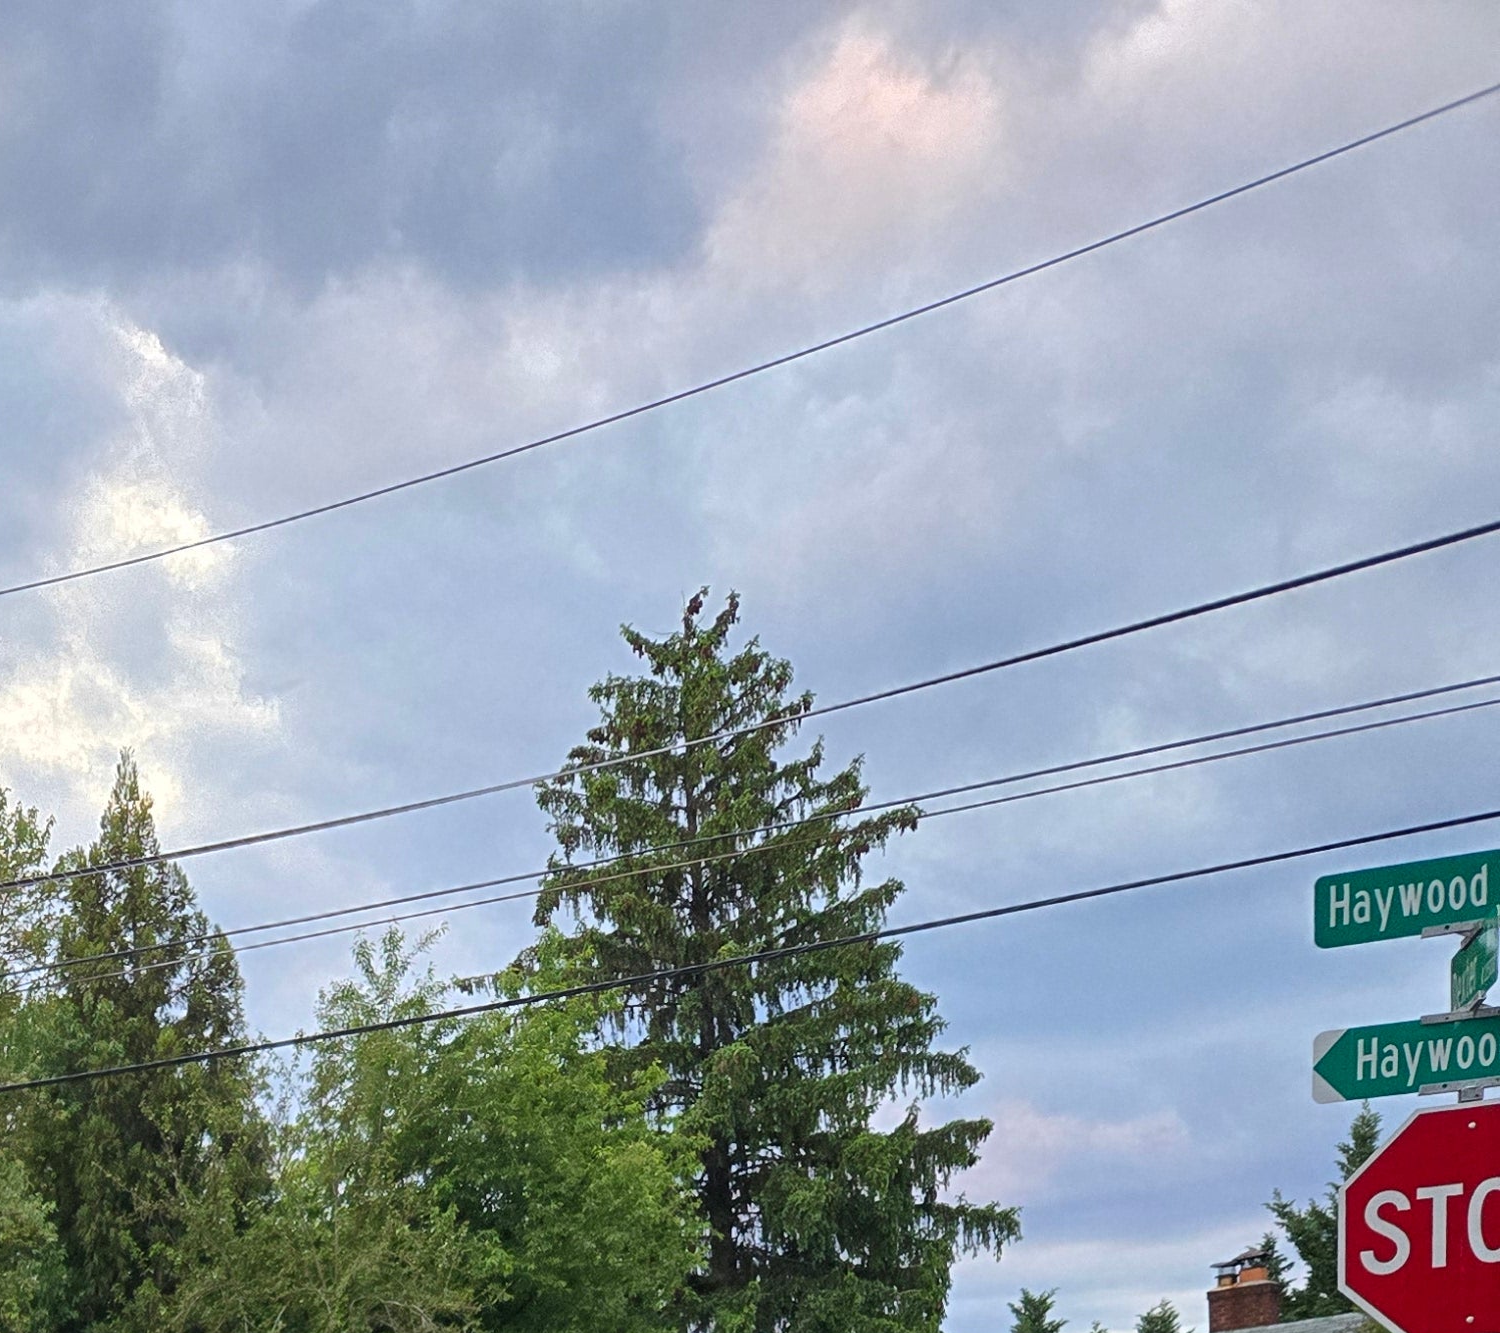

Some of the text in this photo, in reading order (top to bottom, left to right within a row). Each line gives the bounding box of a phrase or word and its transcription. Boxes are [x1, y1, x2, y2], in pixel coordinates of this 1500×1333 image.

[1329, 863, 1488, 932] Haywood
[1356, 1032, 1497, 1087] Haywoo
[1360, 1176, 1500, 1276] STO
